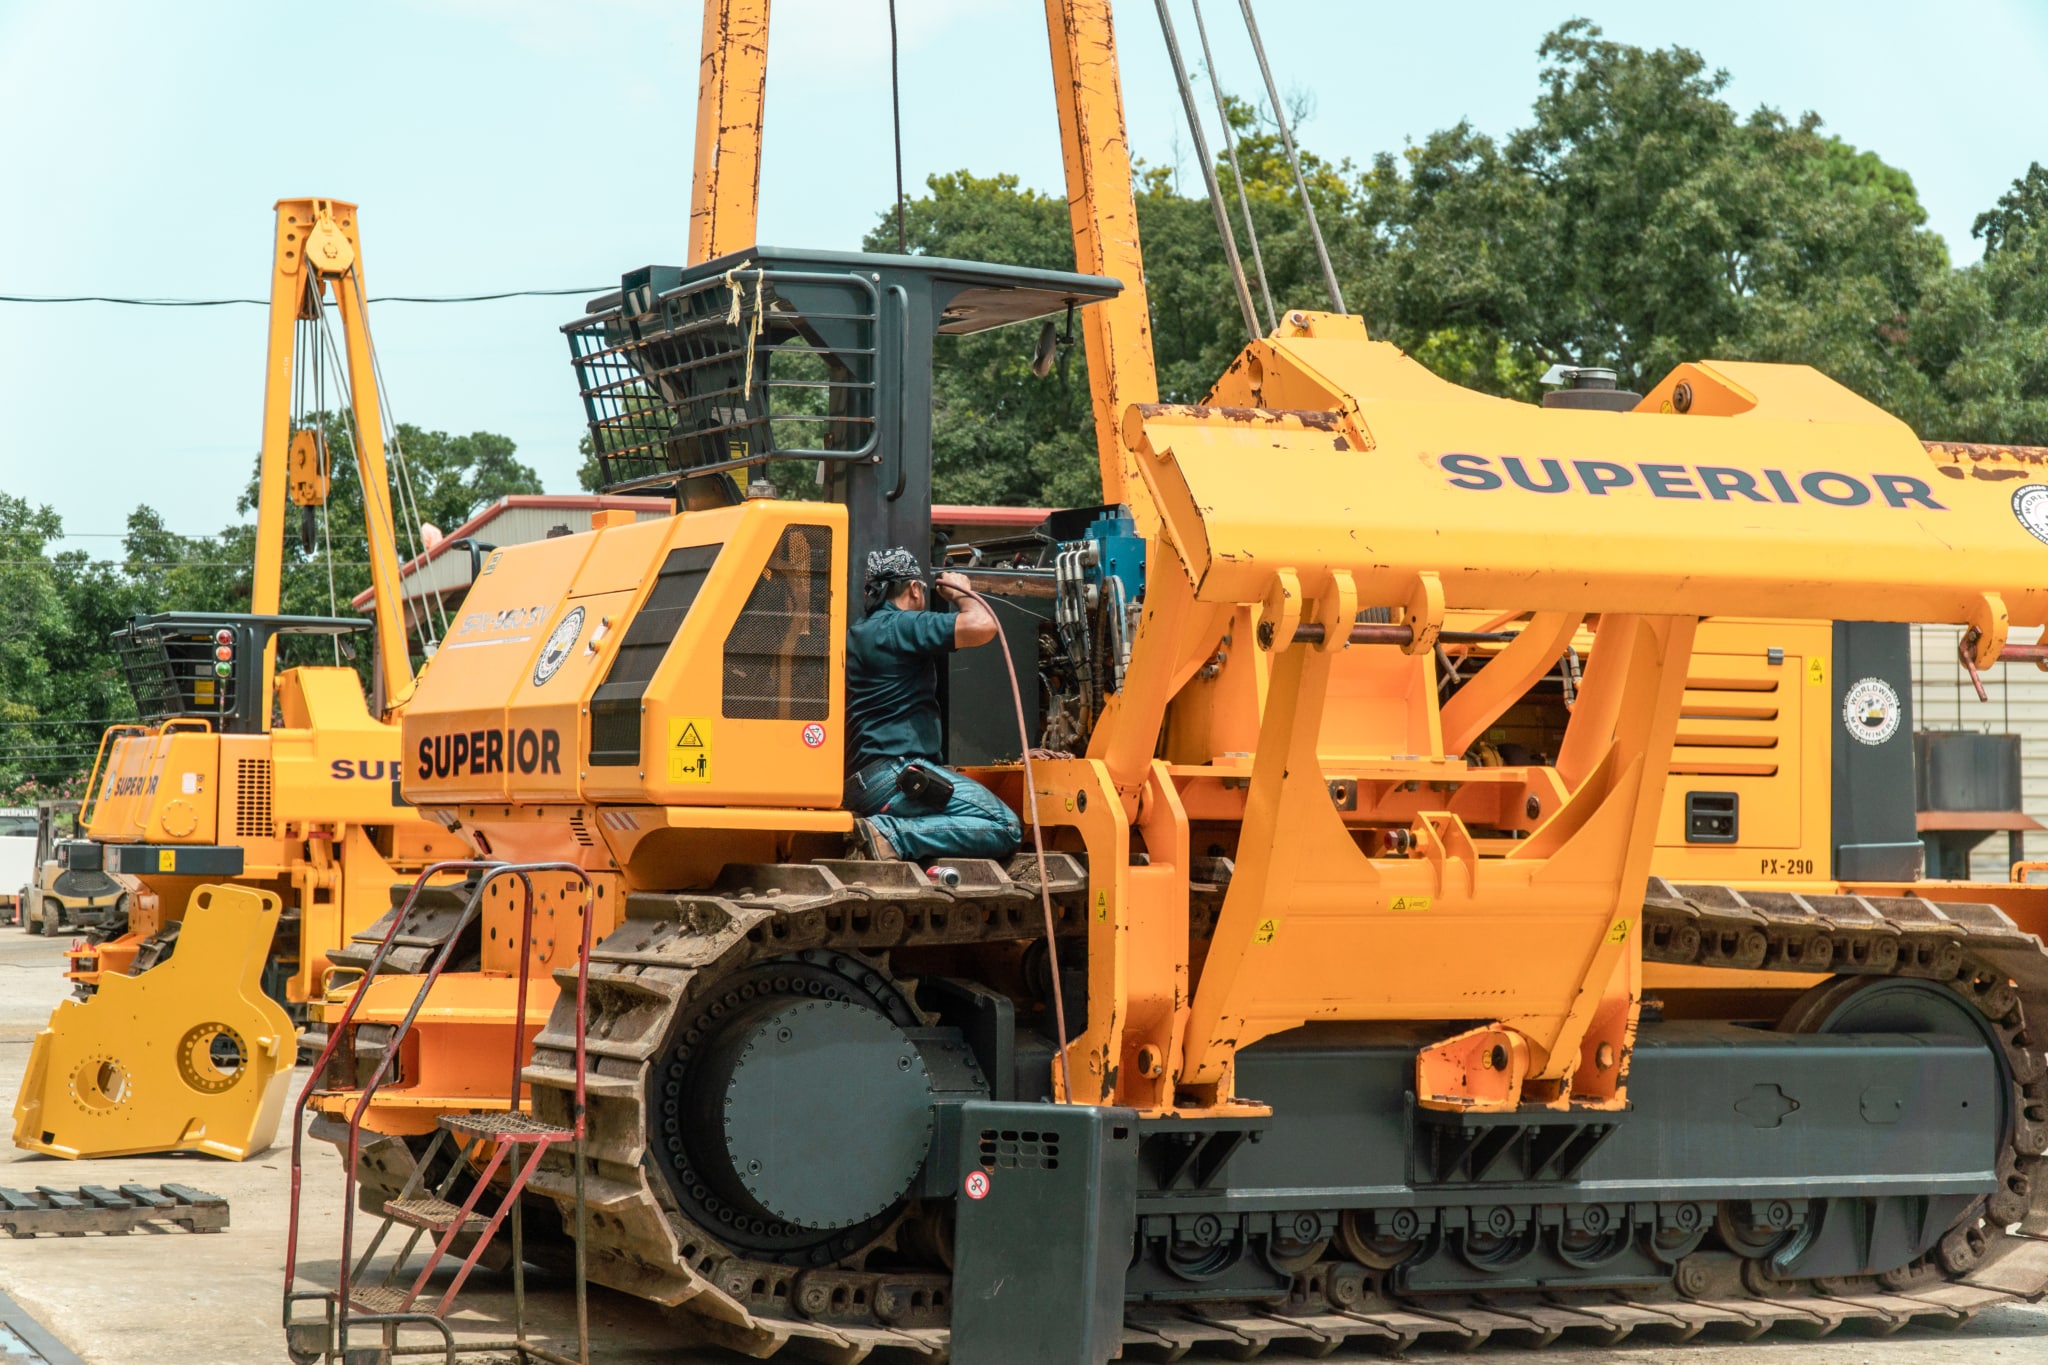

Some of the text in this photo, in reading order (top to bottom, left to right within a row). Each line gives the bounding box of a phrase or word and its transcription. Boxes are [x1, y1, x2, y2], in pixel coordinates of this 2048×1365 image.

[1438, 454, 1949, 511] SUPERIOR
[2024, 493, 2048, 514] WORL
[1850, 684, 1895, 709] WORLDWIDE
[1850, 716, 1894, 739] MACHINERY
[418, 727, 561, 780] SUPERIOR
[0, 807, 37, 817] ATERPILLAR
[1761, 858, 1813, 875] PX-290
